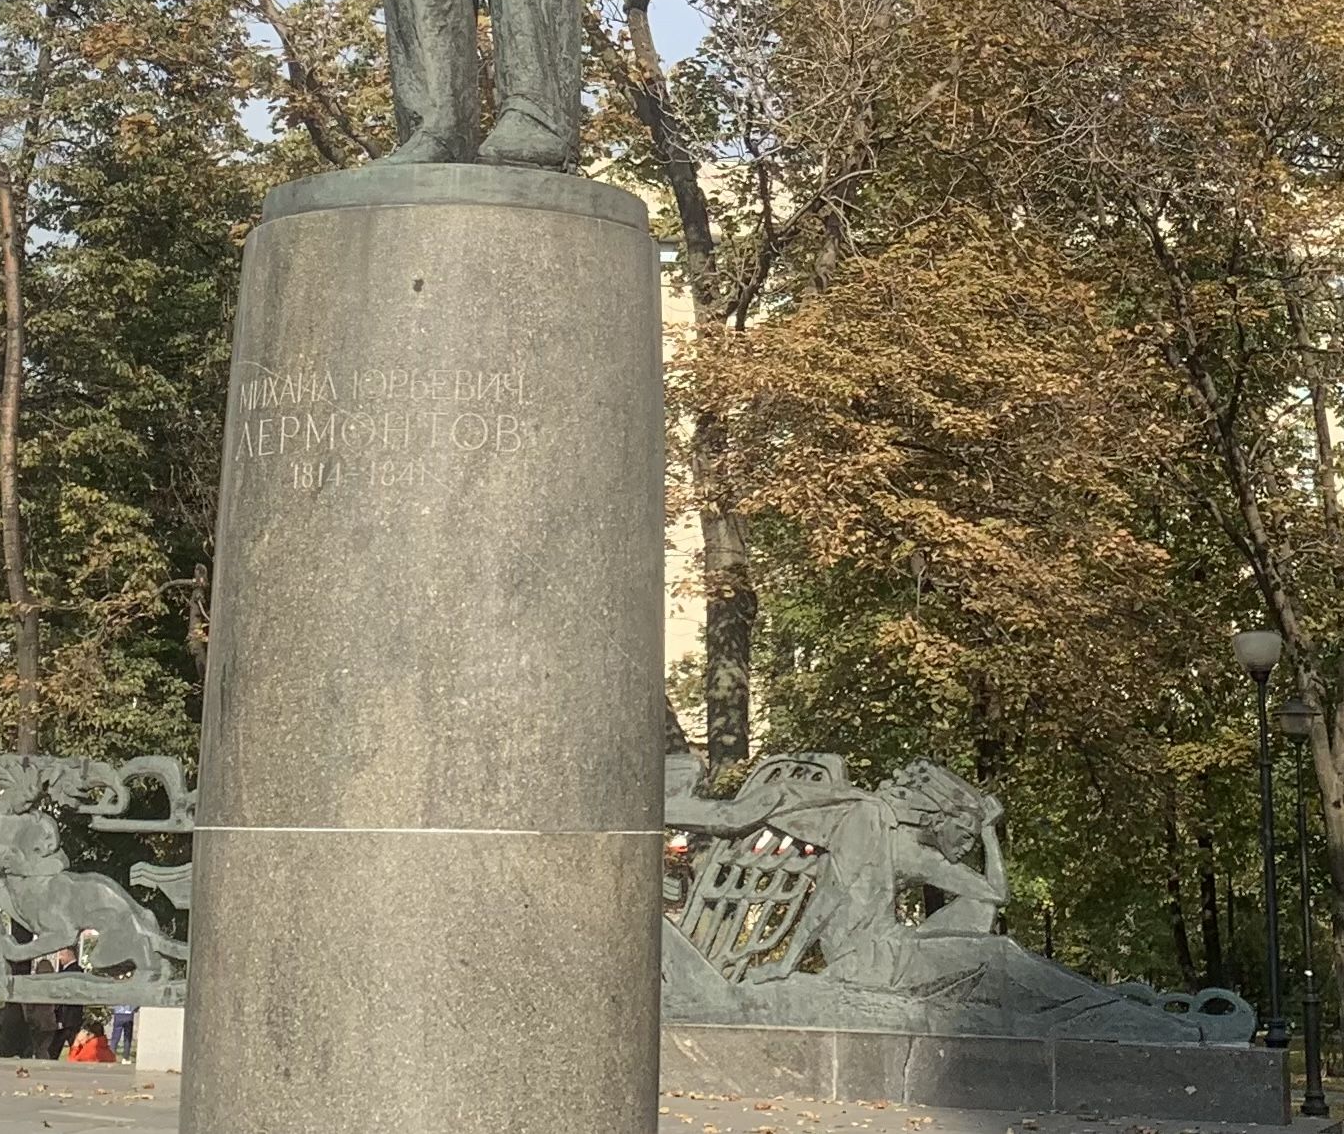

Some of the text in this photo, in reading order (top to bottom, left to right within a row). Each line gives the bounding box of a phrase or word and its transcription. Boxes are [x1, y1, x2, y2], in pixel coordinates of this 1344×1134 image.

[239, 368, 525, 414] МИХАИЛ ЮРЬЕВИЧ
[235, 411, 523, 462] ЛЕРМОНТОВ
